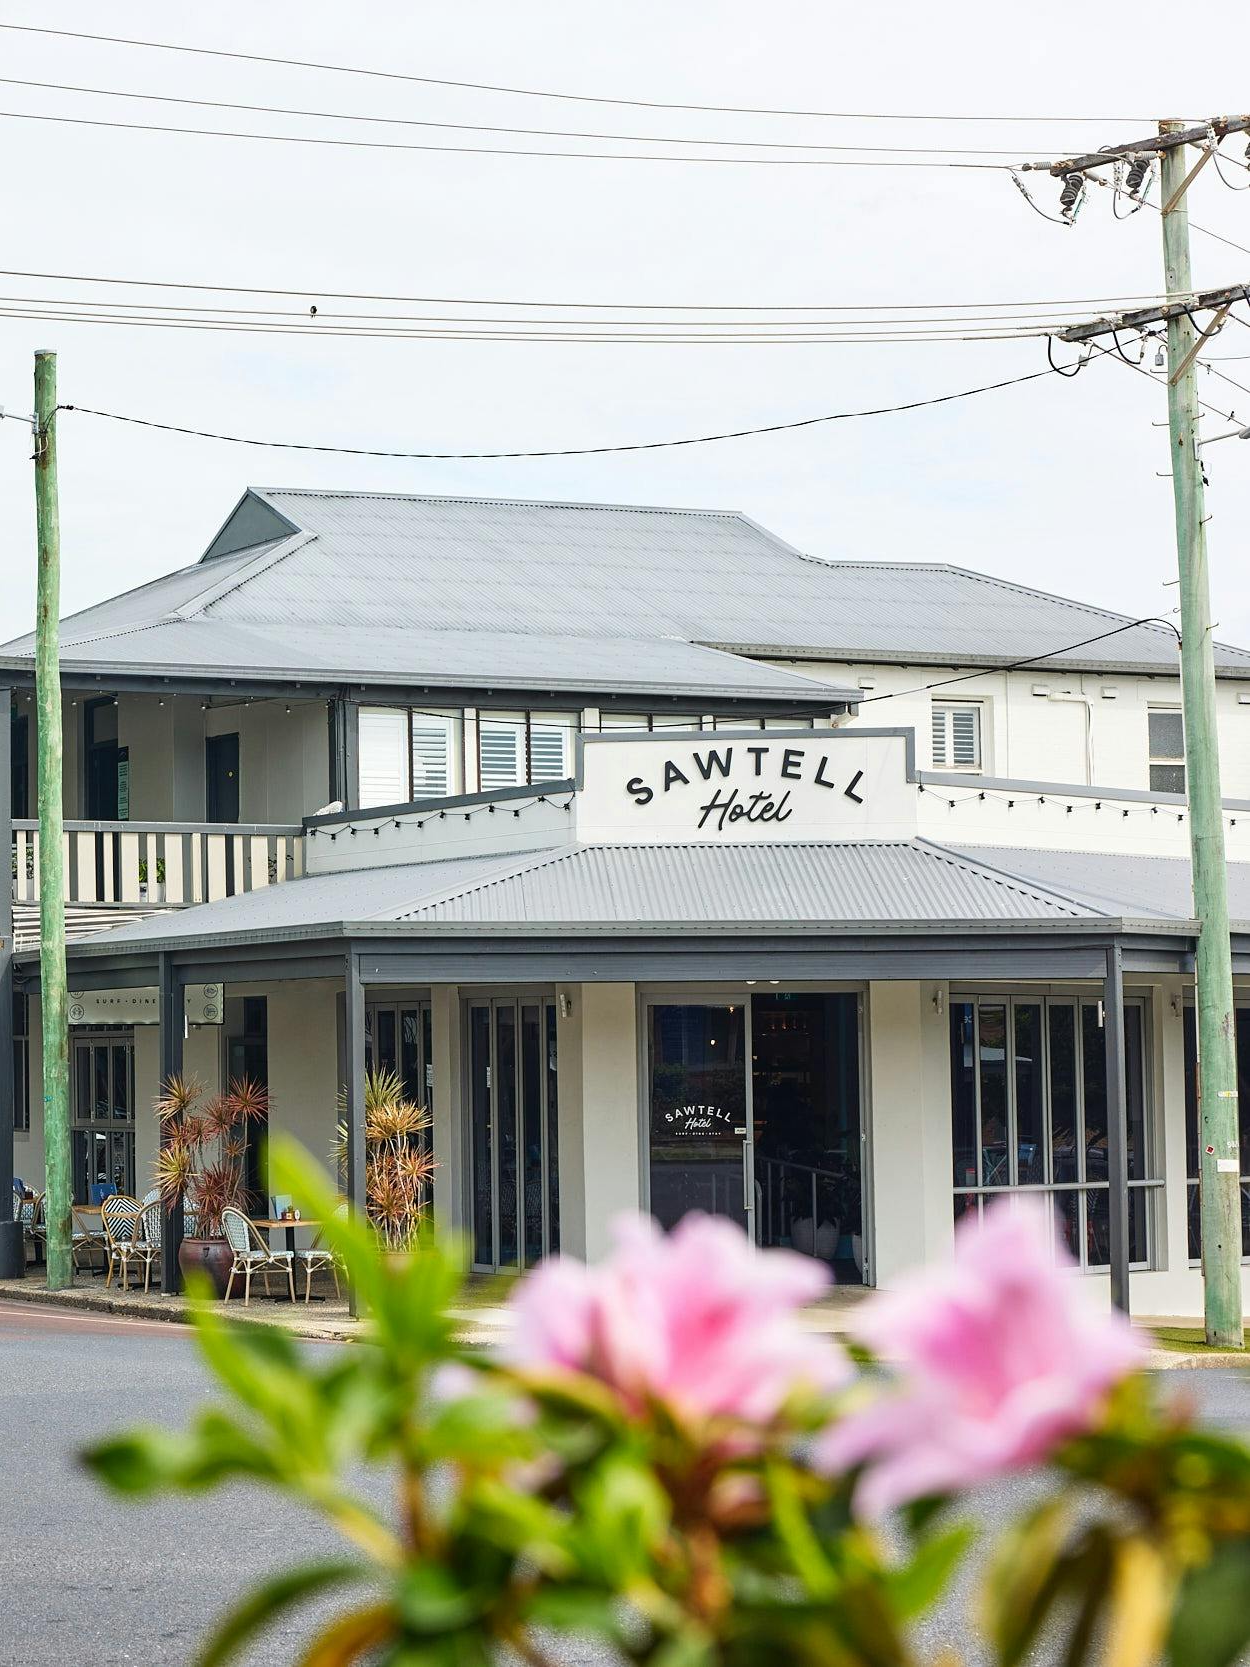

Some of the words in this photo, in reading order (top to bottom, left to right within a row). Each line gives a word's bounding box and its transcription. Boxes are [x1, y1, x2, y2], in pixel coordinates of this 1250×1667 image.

[626, 747, 864, 806] SAWTELL
[697, 788, 793, 831] Hotel
[665, 1105, 731, 1123] SAWTELL
[684, 1117, 712, 1130] Hotel
